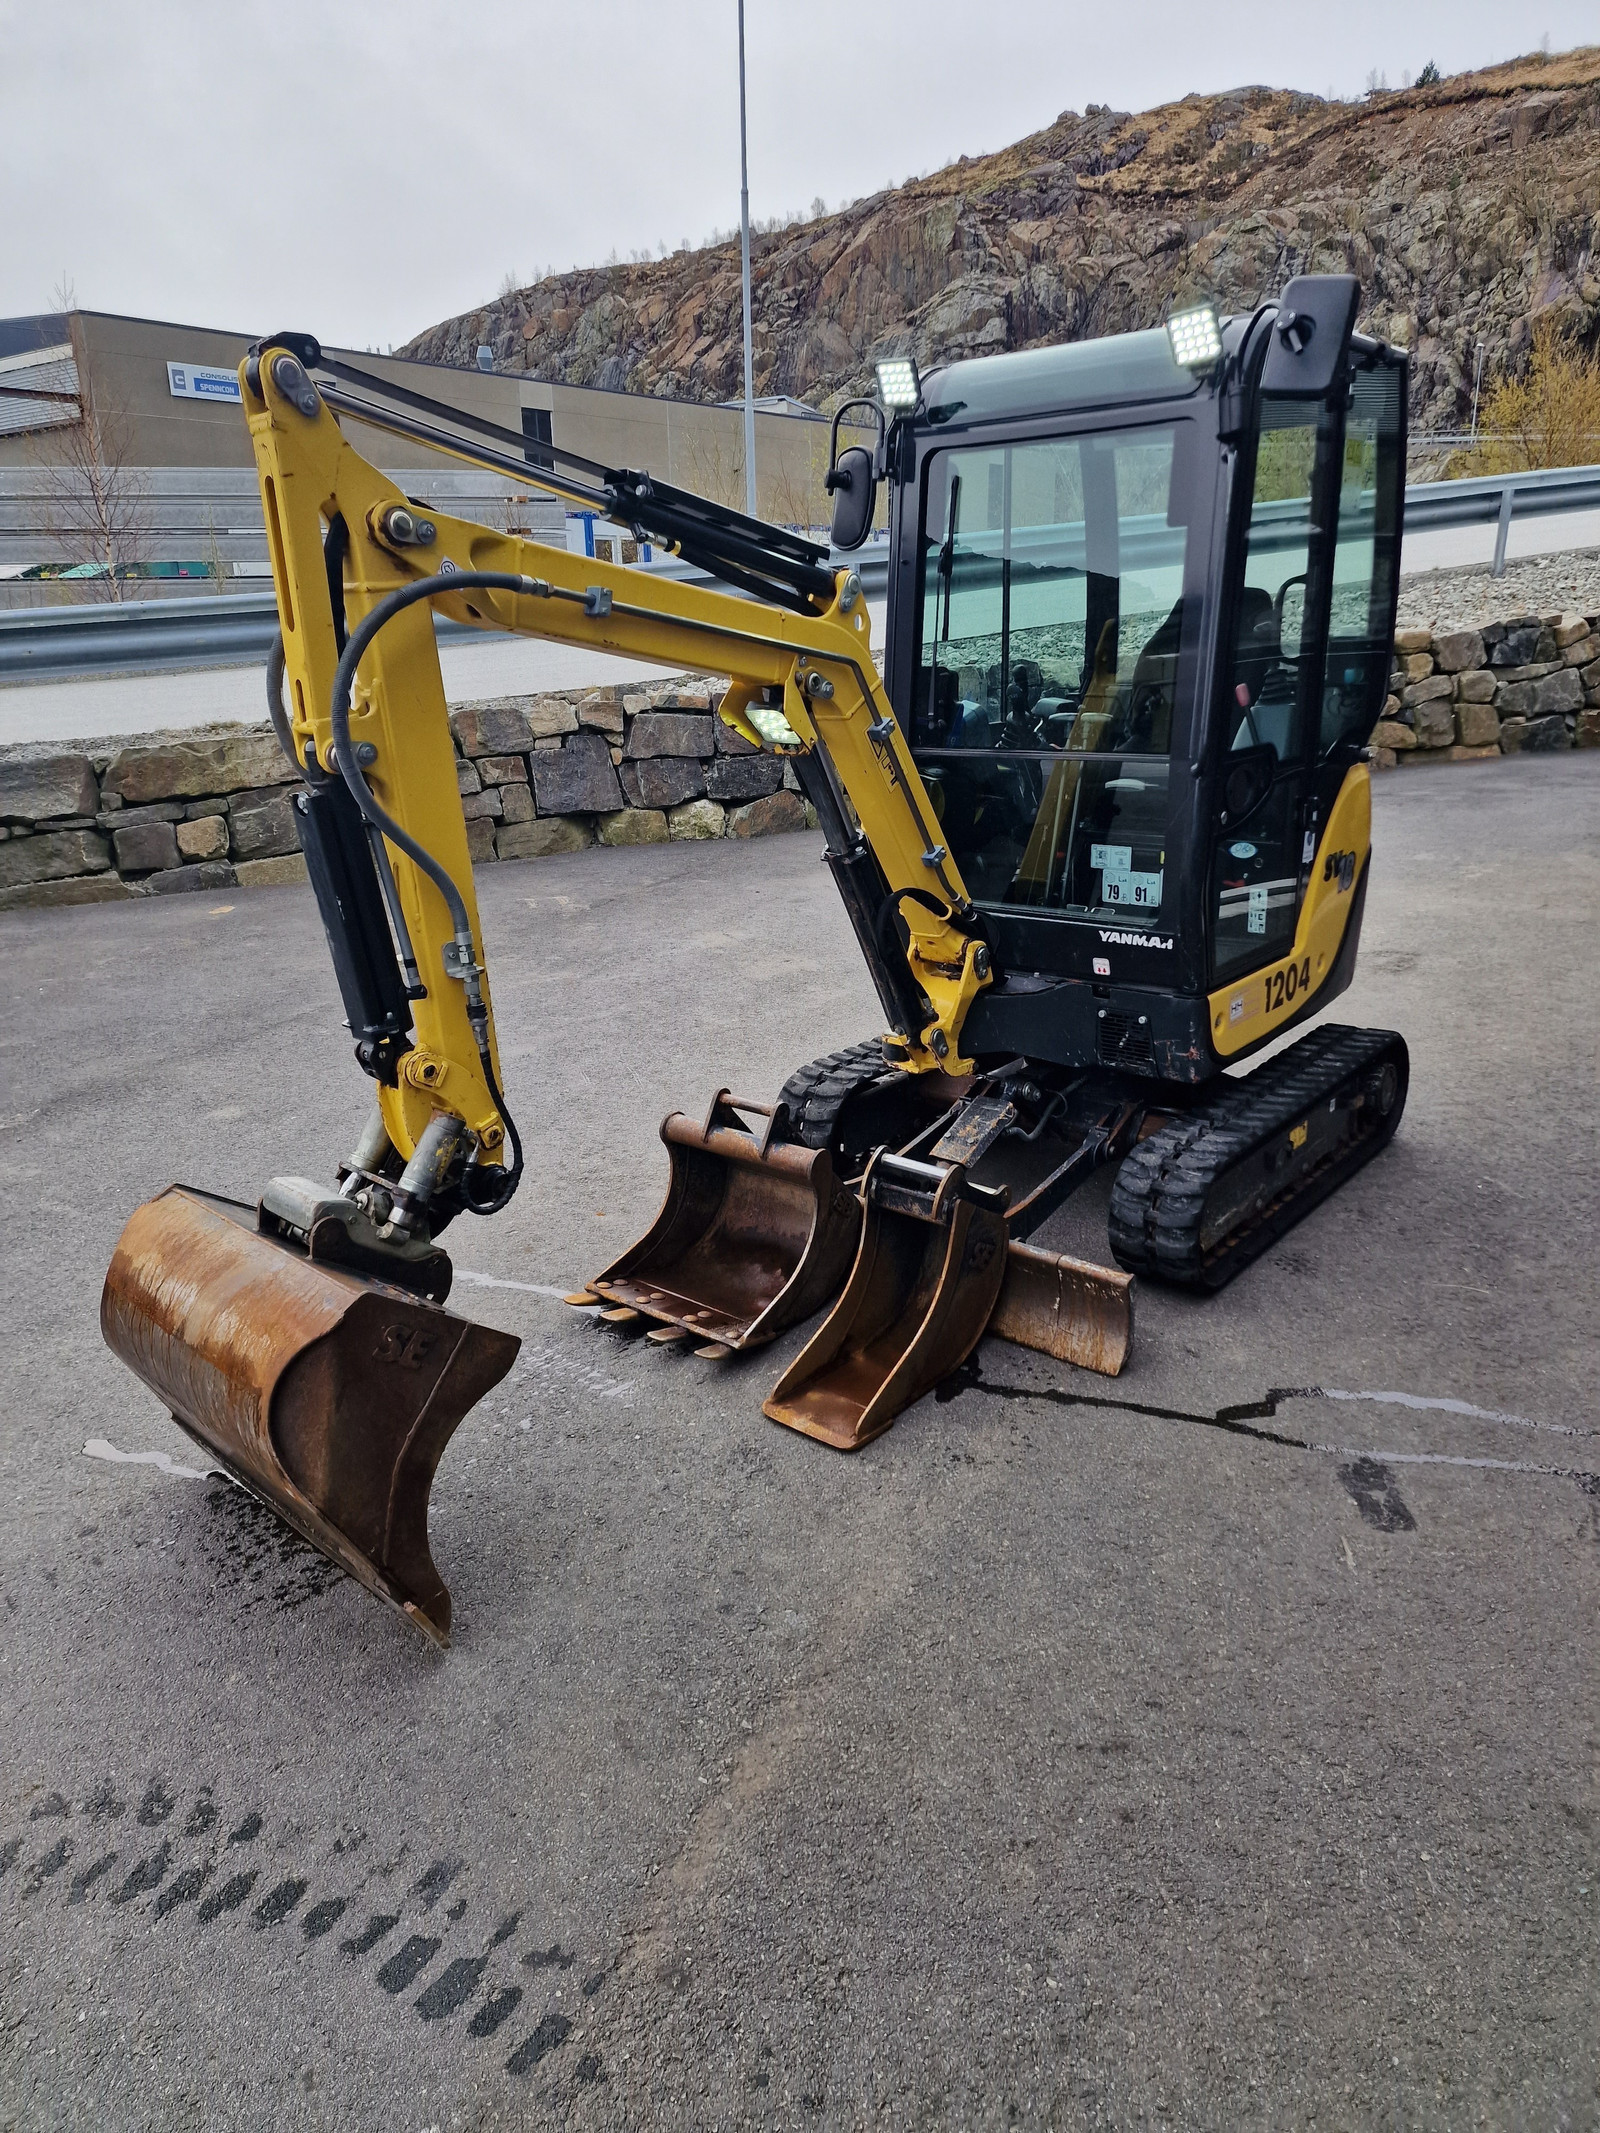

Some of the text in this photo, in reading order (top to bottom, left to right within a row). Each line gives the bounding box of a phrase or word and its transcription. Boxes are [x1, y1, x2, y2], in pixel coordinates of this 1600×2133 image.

[200, 383, 235, 394] SPENNCON
[1107, 884, 1120, 900] 79
[1134, 886, 1148, 903] 91
[1264, 956, 1311, 1014] 1204
[371, 1322, 439, 1371] SE
